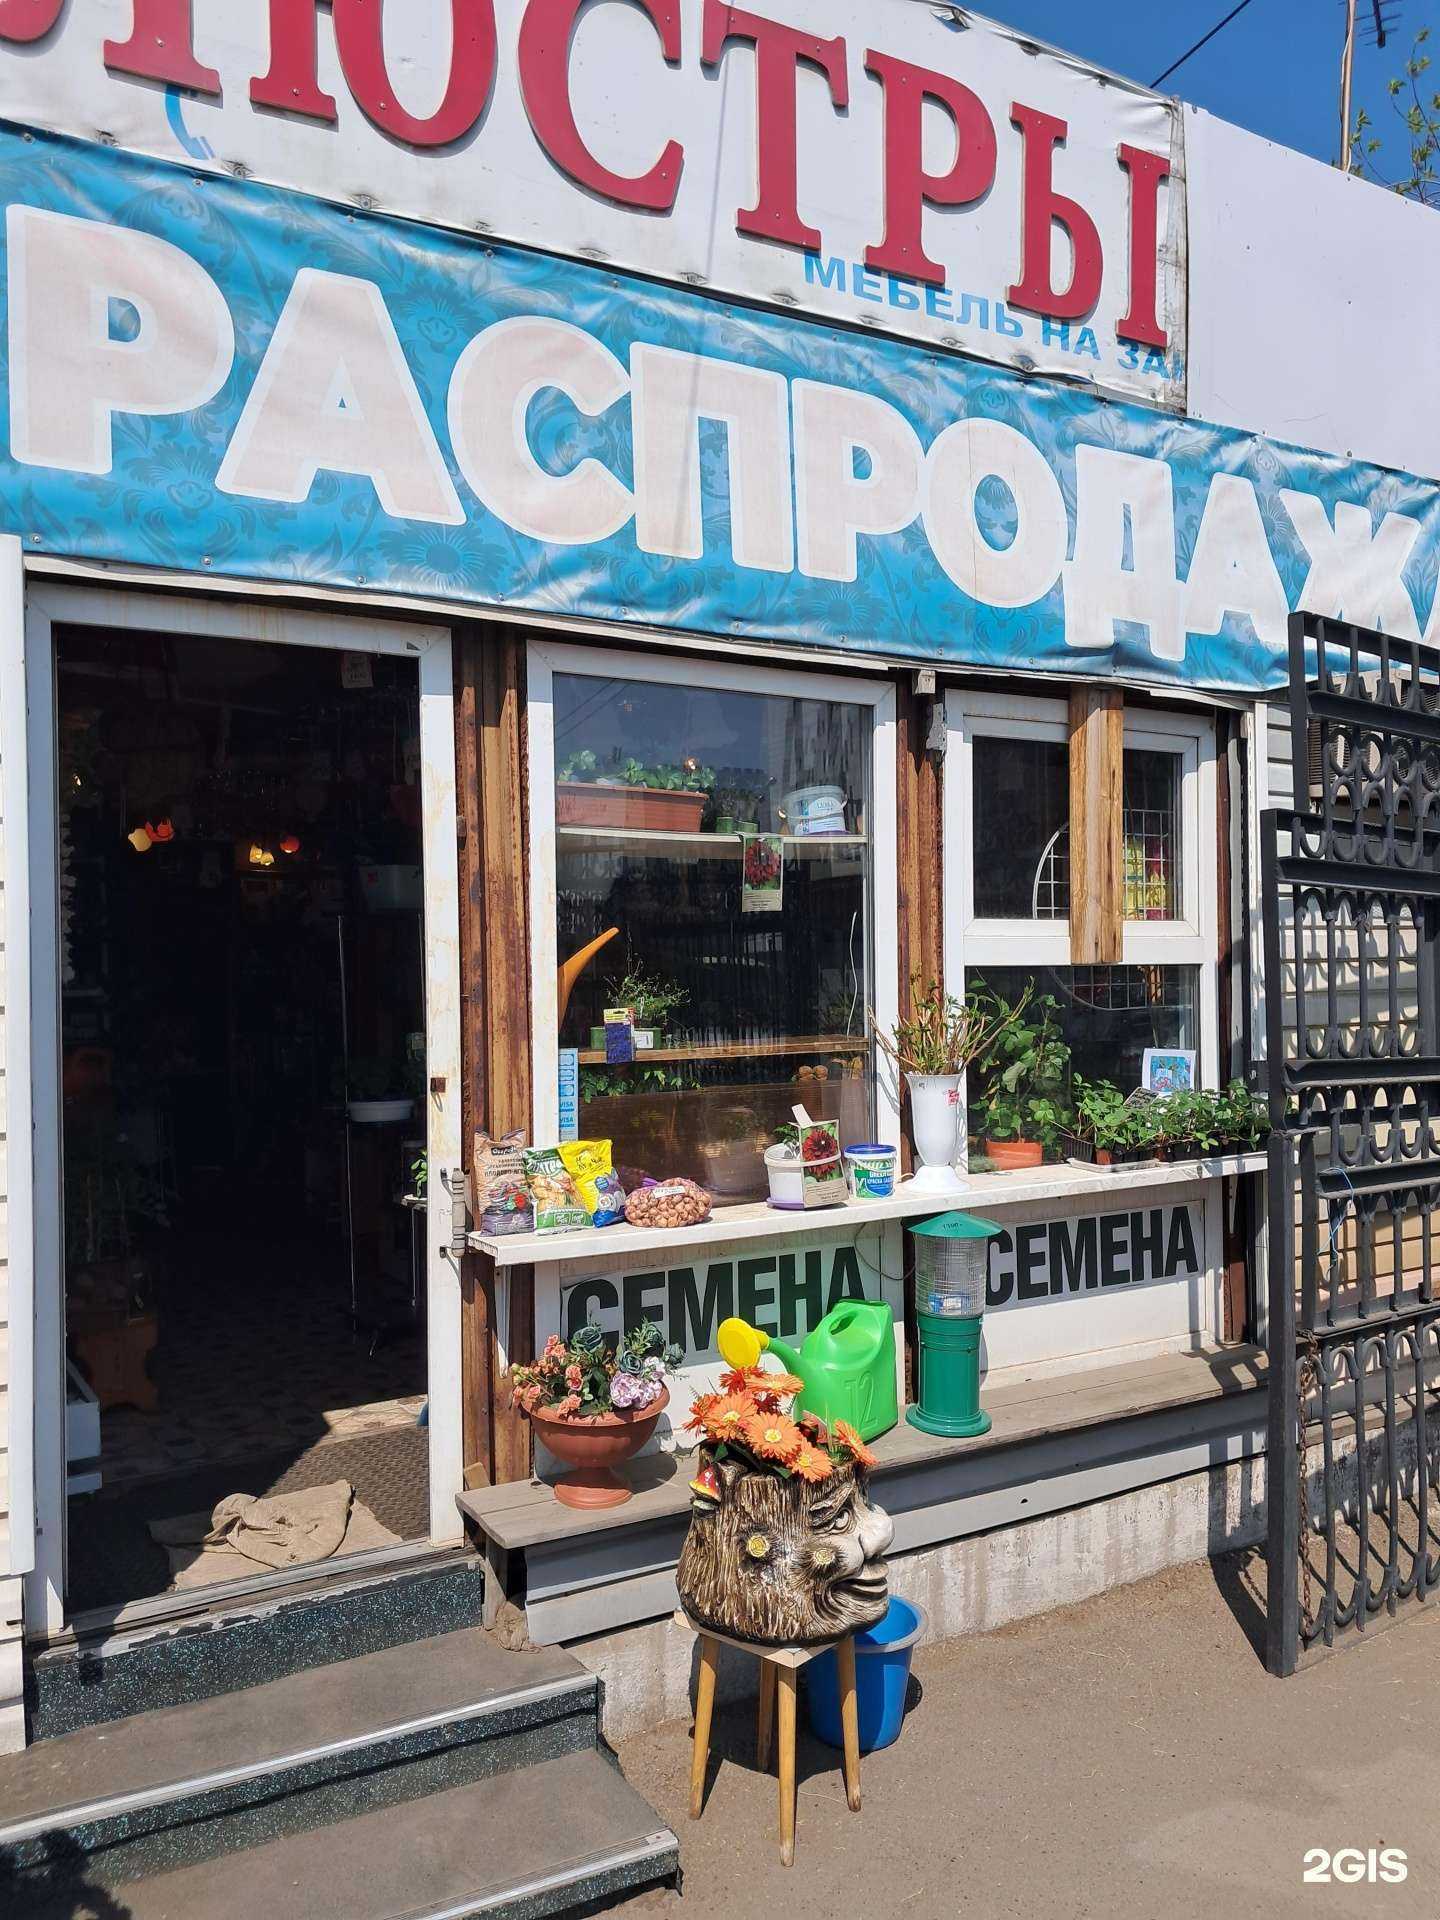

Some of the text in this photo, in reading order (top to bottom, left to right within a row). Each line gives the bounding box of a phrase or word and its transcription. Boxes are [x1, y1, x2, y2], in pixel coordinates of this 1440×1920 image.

[0, 0, 1170, 346] ЮСТРЫ
[804, 250, 1023, 340] МЕБЕЛЬ
[1041, 313, 1102, 361] НА
[6, 203, 1440, 661] РАСПРОДАЖ
[566, 1247, 866, 1354] СЕМЕНА
[986, 1206, 1198, 1307] СЕМЕНА
